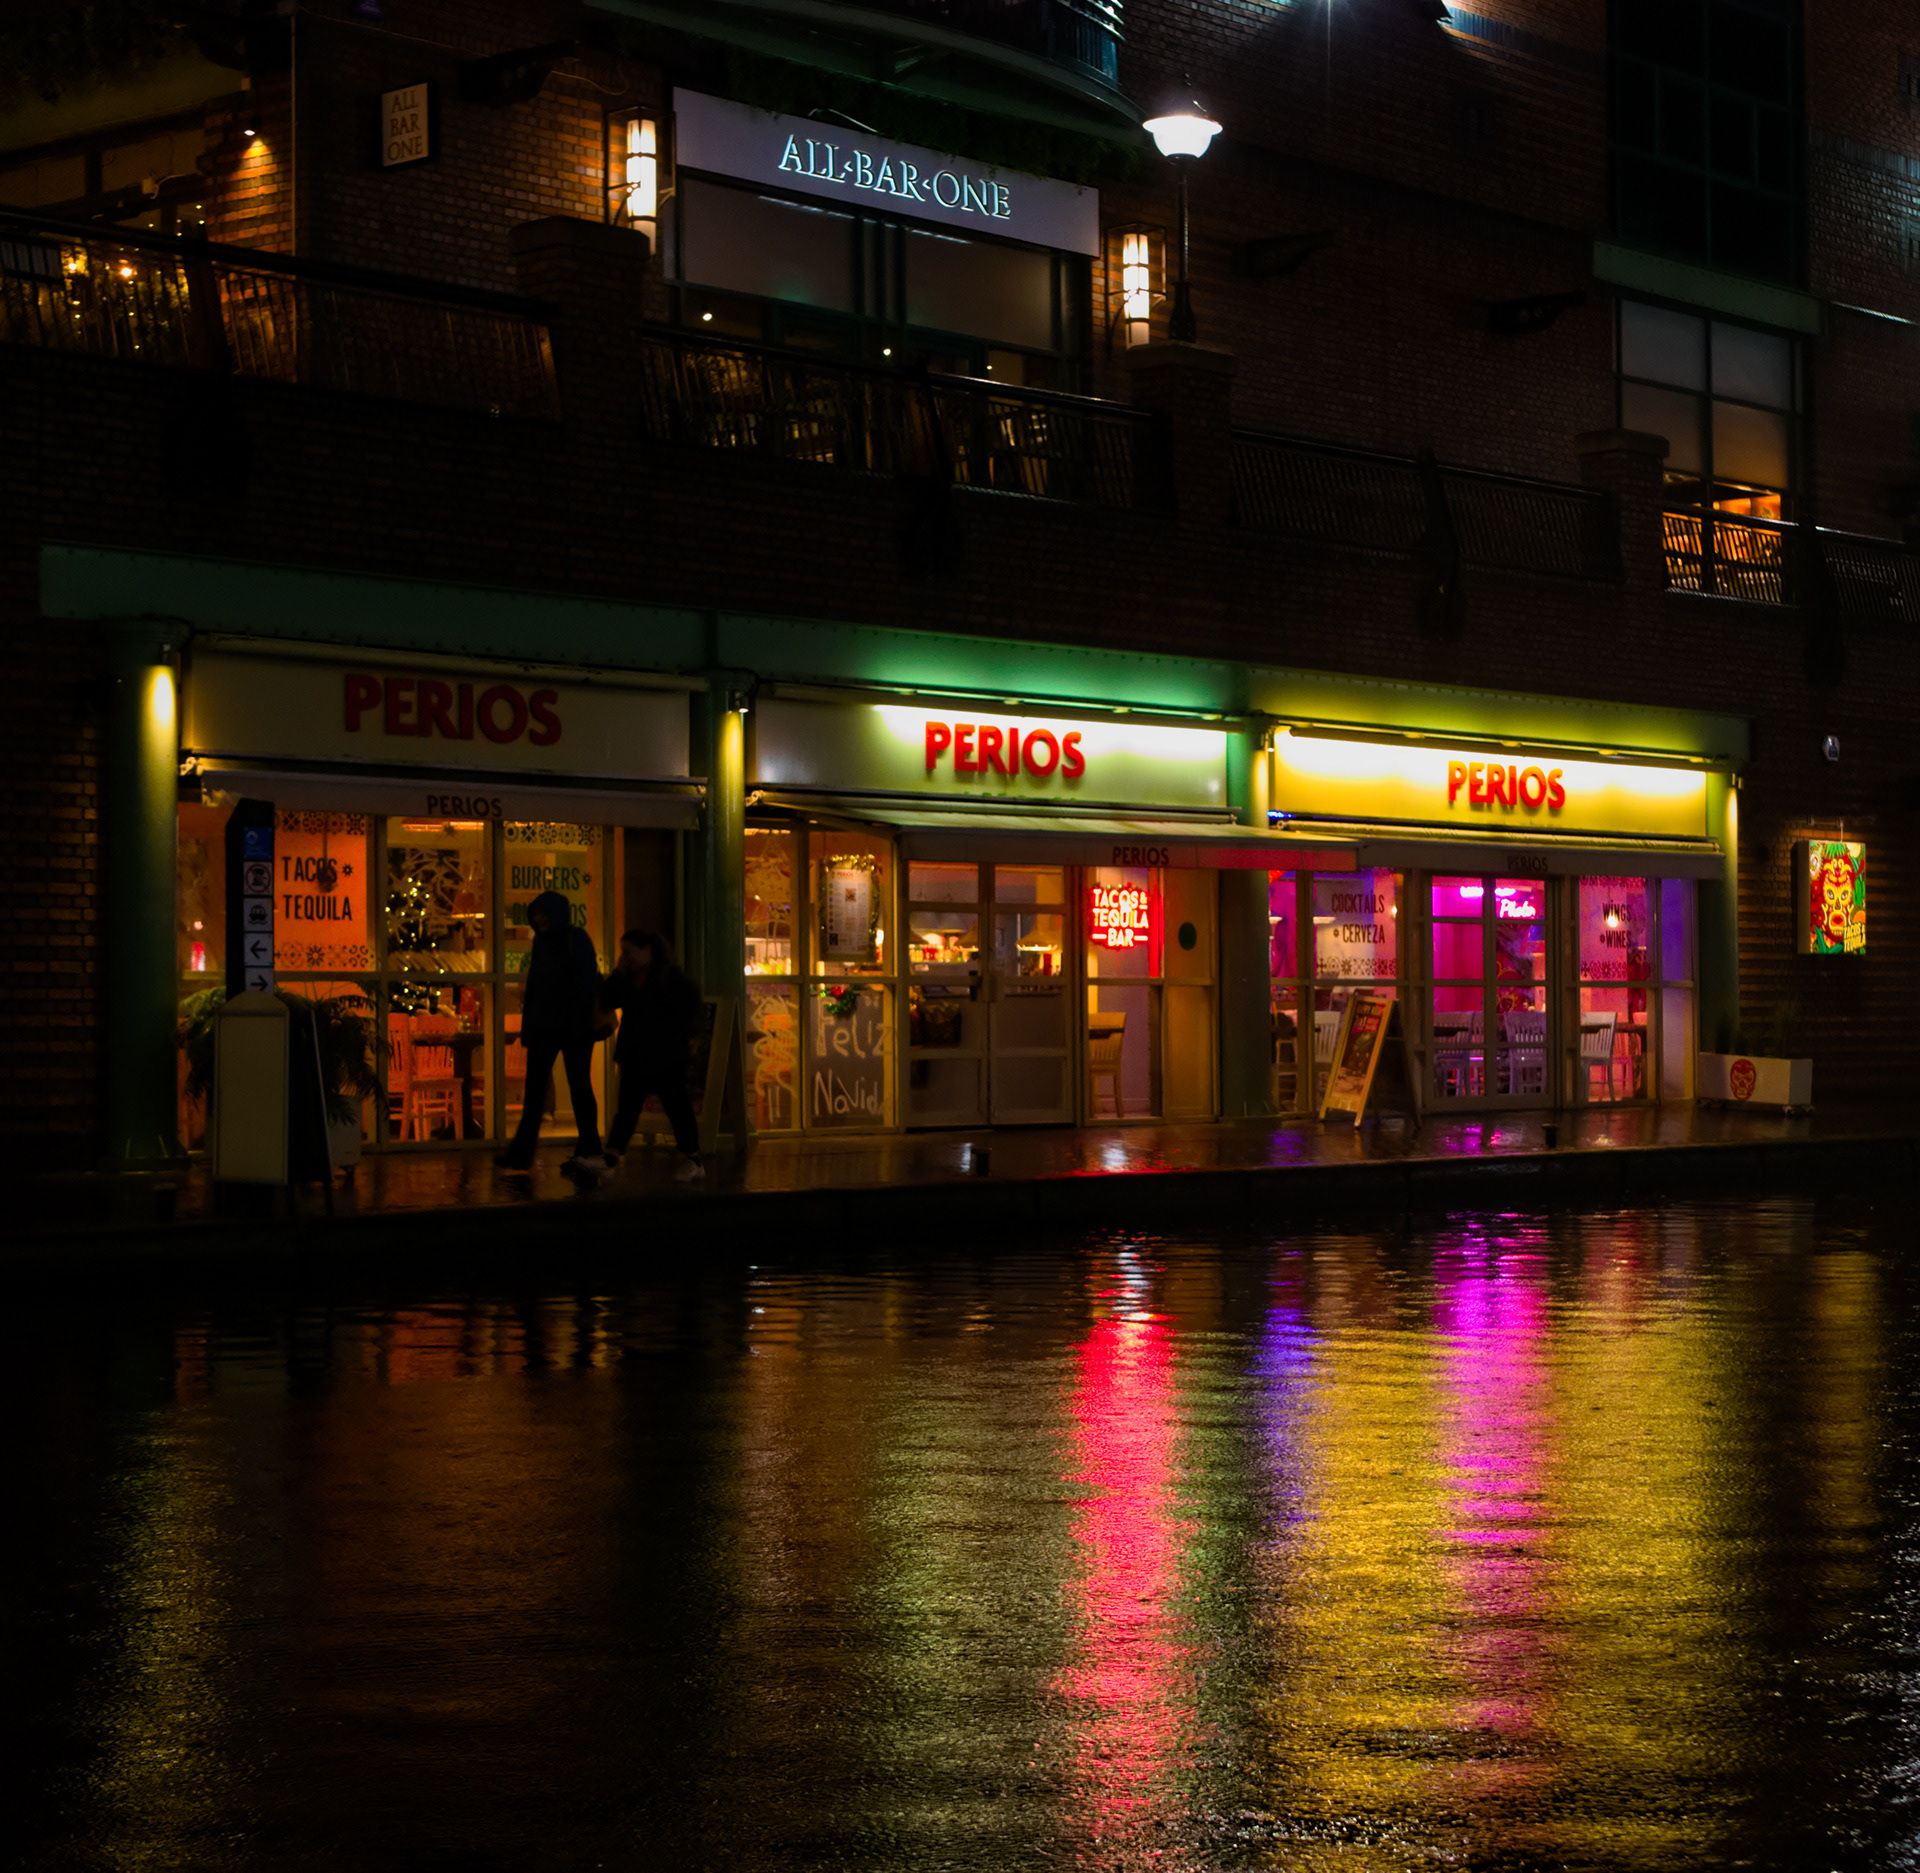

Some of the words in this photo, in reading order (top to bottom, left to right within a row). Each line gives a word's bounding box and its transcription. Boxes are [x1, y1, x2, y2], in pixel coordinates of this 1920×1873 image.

[391, 90, 419, 113] ALL
[391, 113, 420, 138] BAR
[388, 136, 423, 161] ONE
[345, 673, 562, 746] PERIOS
[925, 721, 1086, 779] PERIOS
[1448, 760, 1566, 809] PERIOS
[427, 795, 502, 816] PERIOS
[1112, 846, 1169, 866] PERIOS
[1507, 855, 1548, 872] PERIOS
[282, 856, 338, 886] TACOS
[511, 865, 580, 890] BURGERS
[283, 894, 352, 921] TEQUILA
[1093, 888, 1139, 909] TACOS
[1092, 908, 1149, 929] TEQUILA
[1107, 927, 1134, 947] BAR
[1342, 924, 1386, 944] CERVEZA
[1605, 929, 1632, 949] WINES
